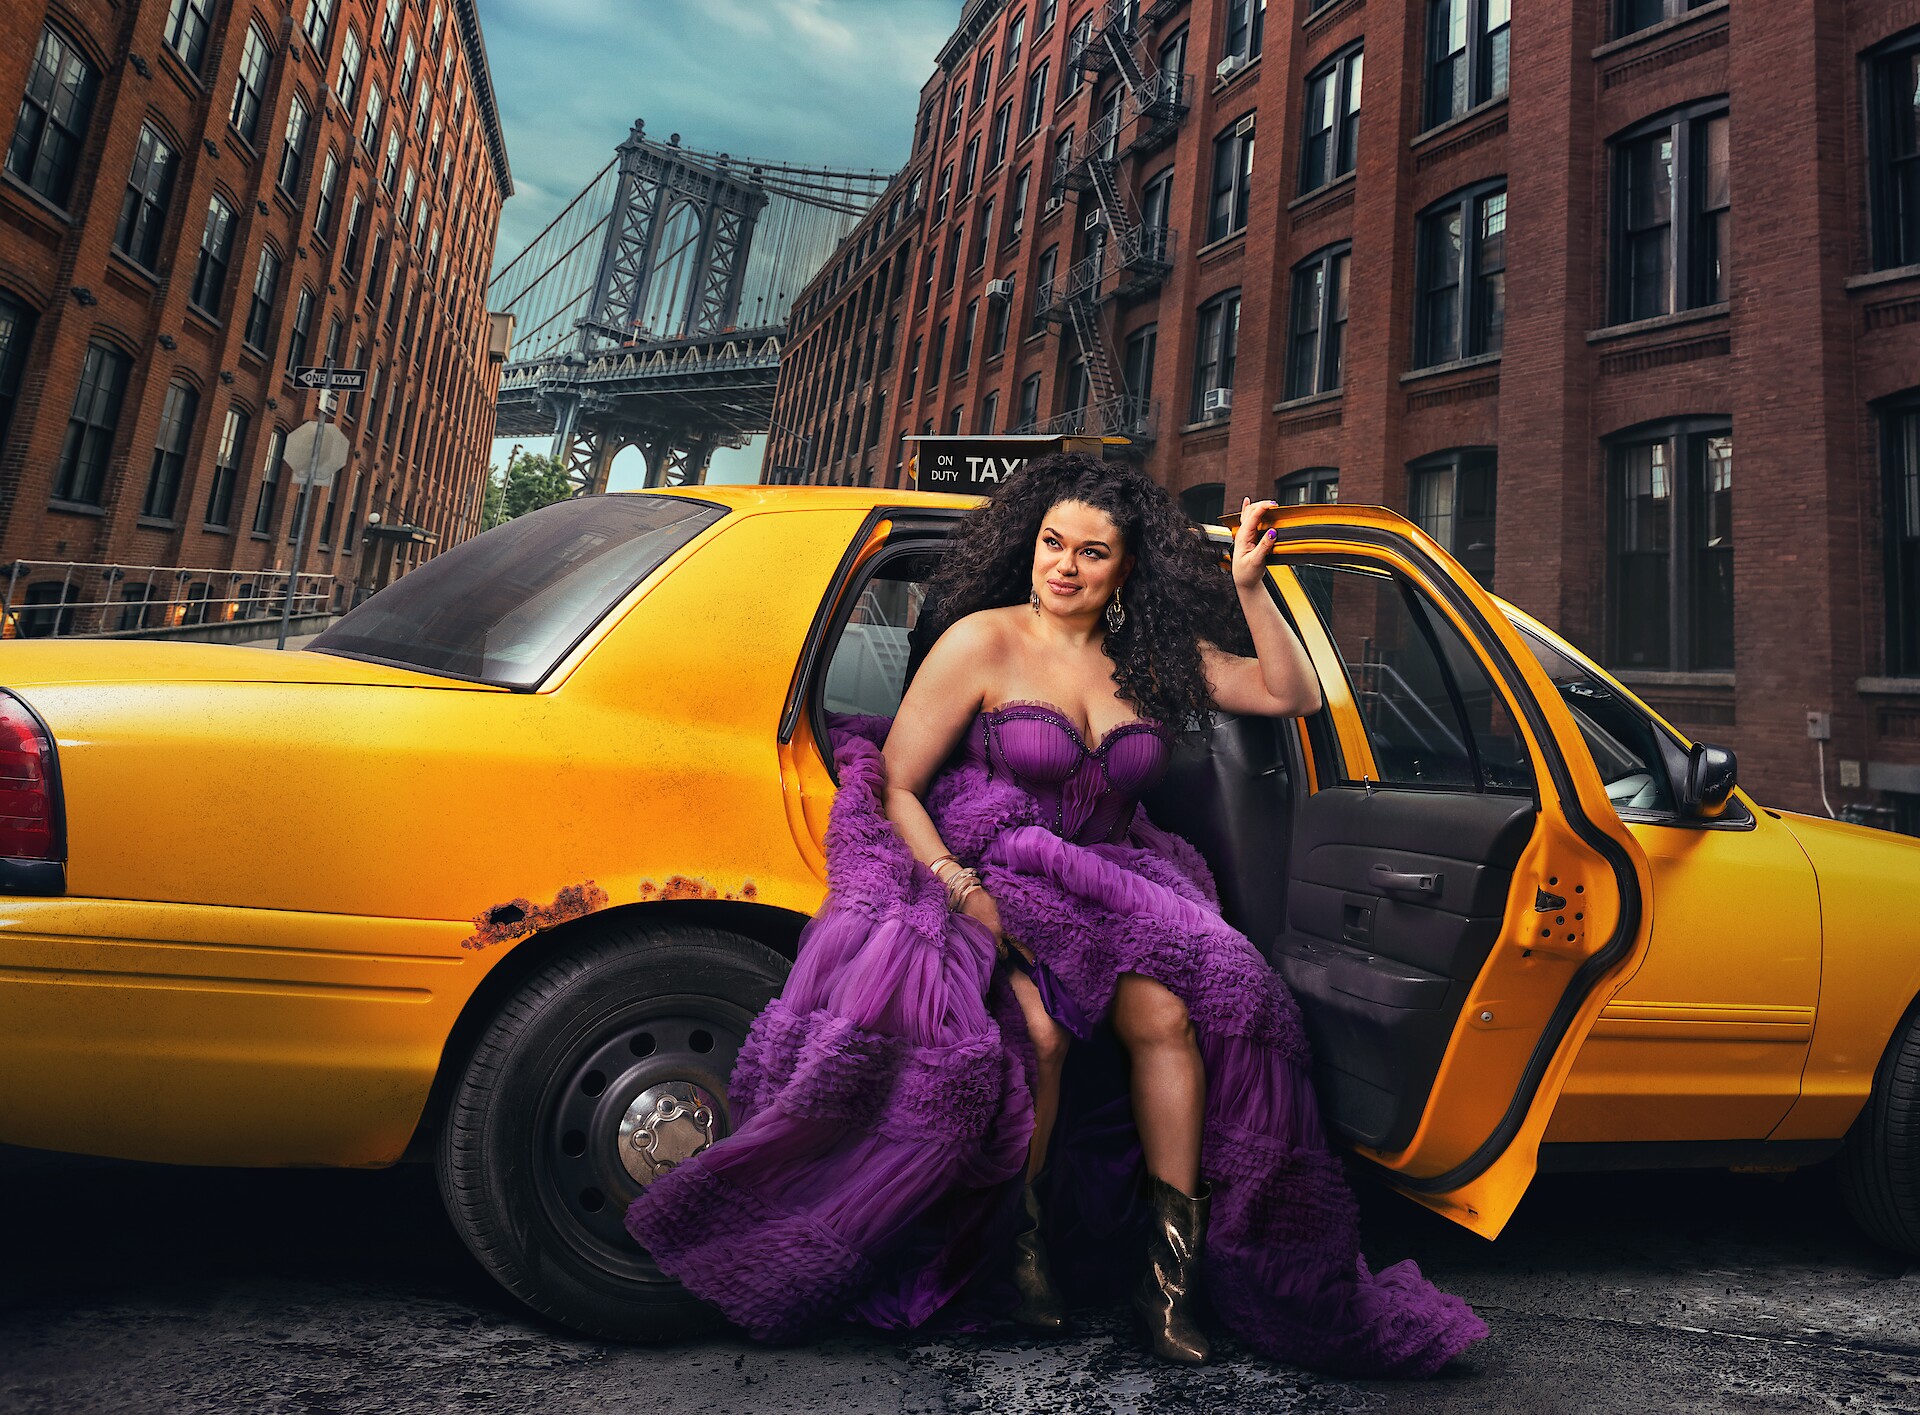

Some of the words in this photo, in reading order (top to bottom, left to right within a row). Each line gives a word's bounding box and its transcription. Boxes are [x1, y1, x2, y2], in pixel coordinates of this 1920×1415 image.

[305, 373, 326, 383] ONE
[335, 375, 356, 384] WAY
[937, 455, 953, 466] ON
[931, 470, 959, 482] DUTY
